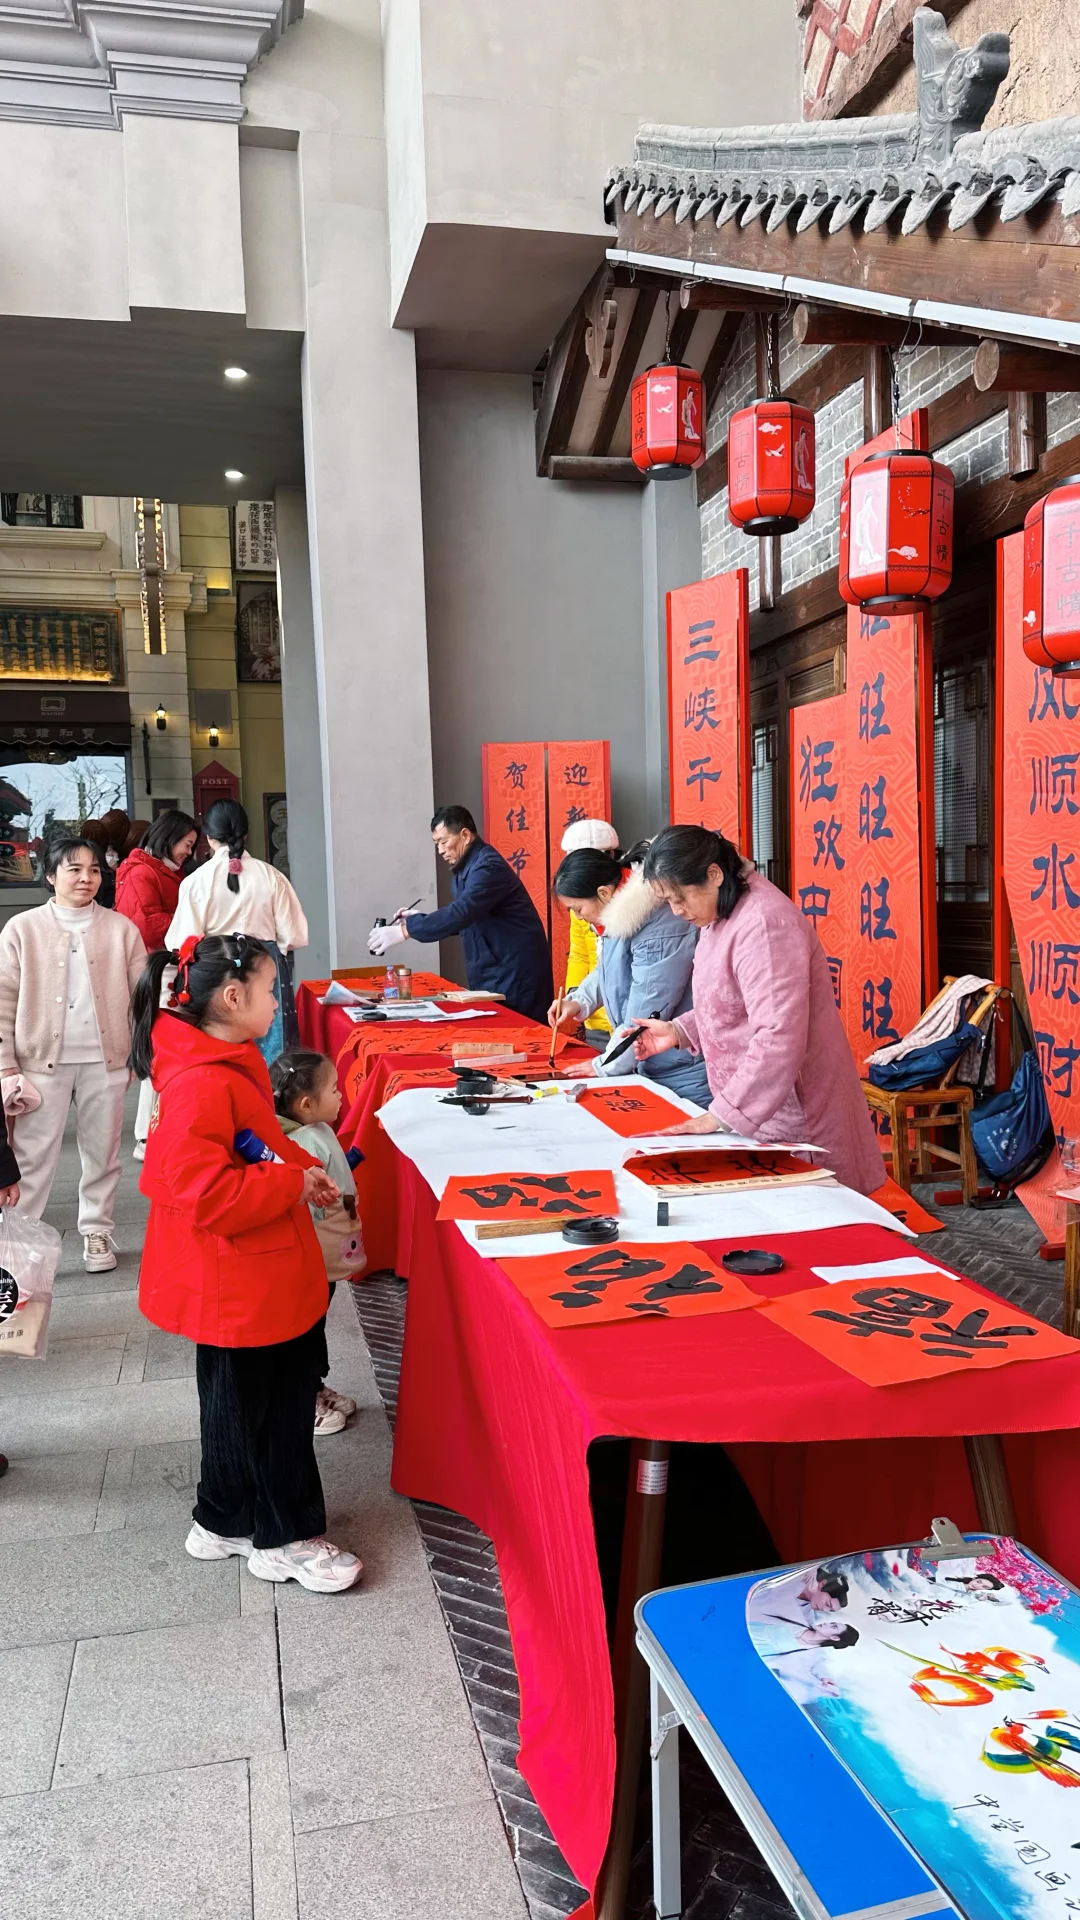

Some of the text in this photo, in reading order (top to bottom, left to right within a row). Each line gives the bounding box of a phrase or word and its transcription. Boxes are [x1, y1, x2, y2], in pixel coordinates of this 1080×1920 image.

[634, 390, 645, 442] 千古情
[734, 430, 750, 491] 千古情
[936, 488, 950, 564] 千古情
[1056, 521, 1080, 620] 千古情
[684, 619, 723, 836] 三峡千
[504, 761, 531, 876] 贺佳节
[808, 1287, 1039, 1359] 福
